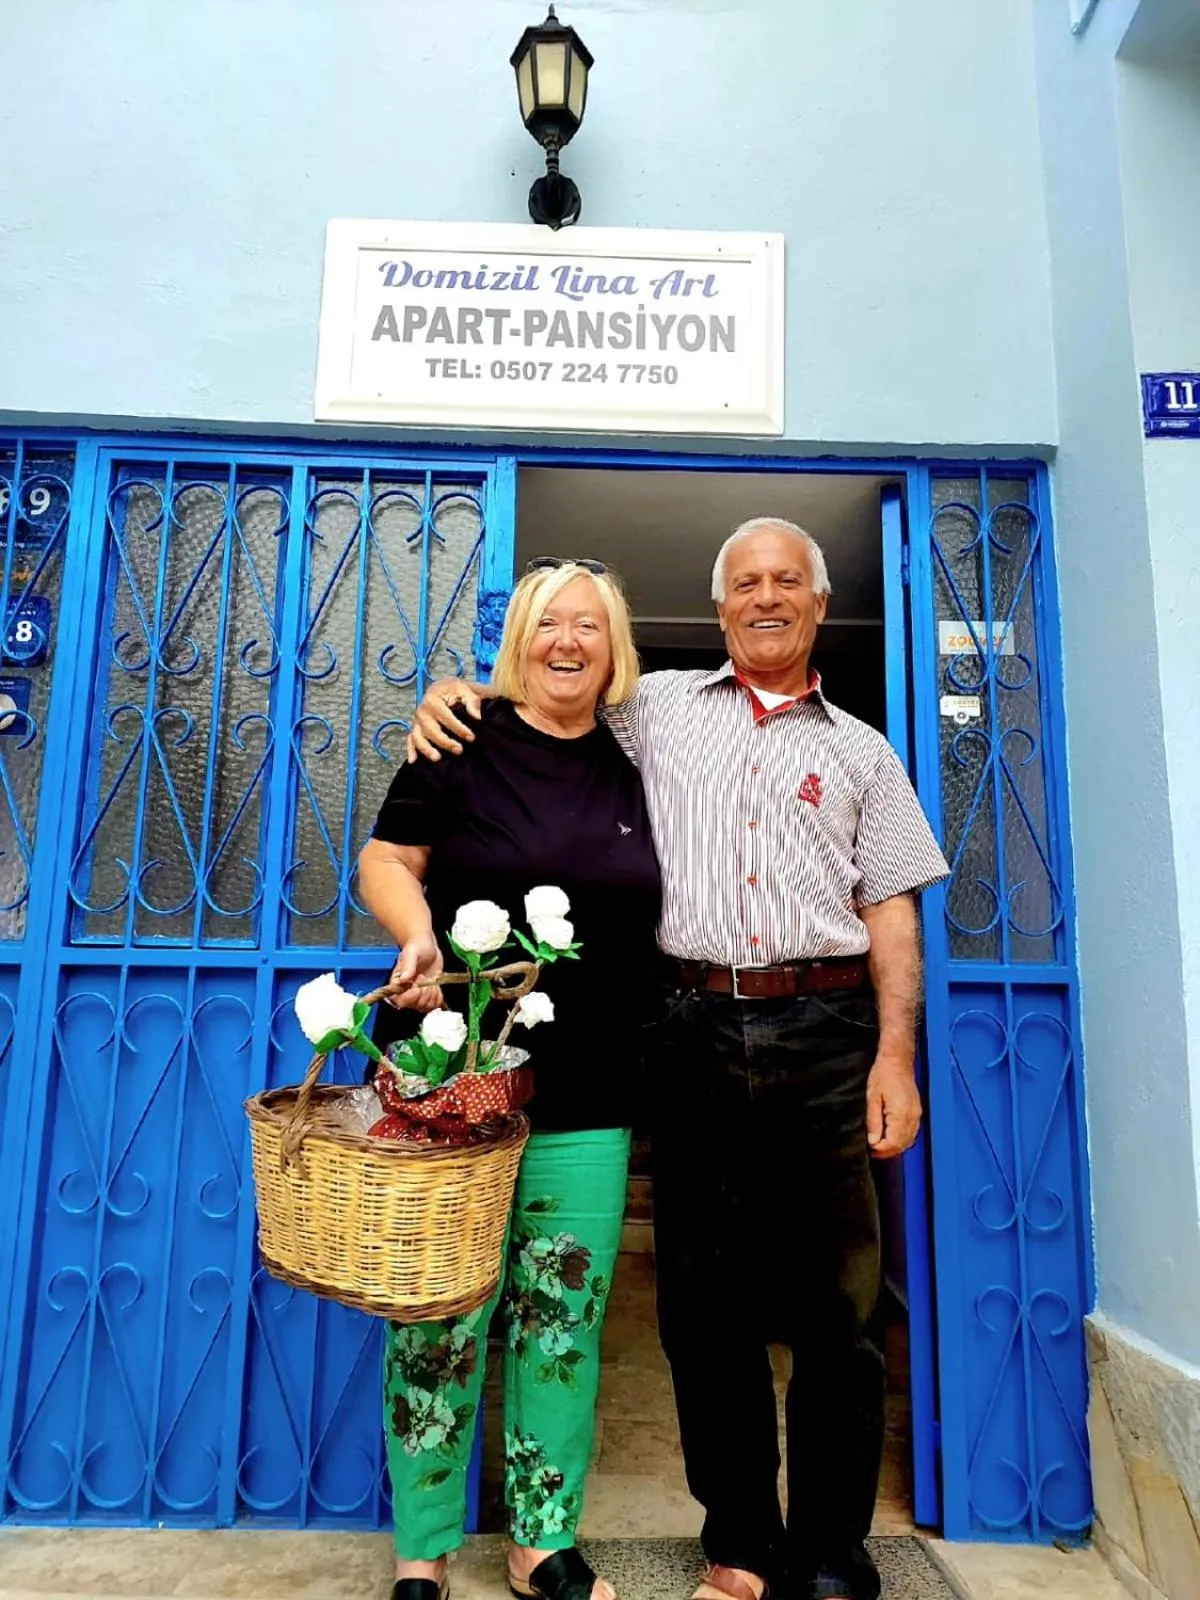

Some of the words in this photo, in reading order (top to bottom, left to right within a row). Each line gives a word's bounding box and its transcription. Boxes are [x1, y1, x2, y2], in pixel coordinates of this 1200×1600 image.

[378, 260, 540, 291] Domizil
[550, 265, 640, 302] Lina
[649, 269, 719, 300] Art
[371, 303, 736, 353] APART-PANSİYON
[425, 358, 482, 379] TEL:
[490, 360, 553, 382] 0507
[561, 362, 608, 384] 224
[617, 364, 678, 385] 7750
[1164, 381, 1198, 409] 11
